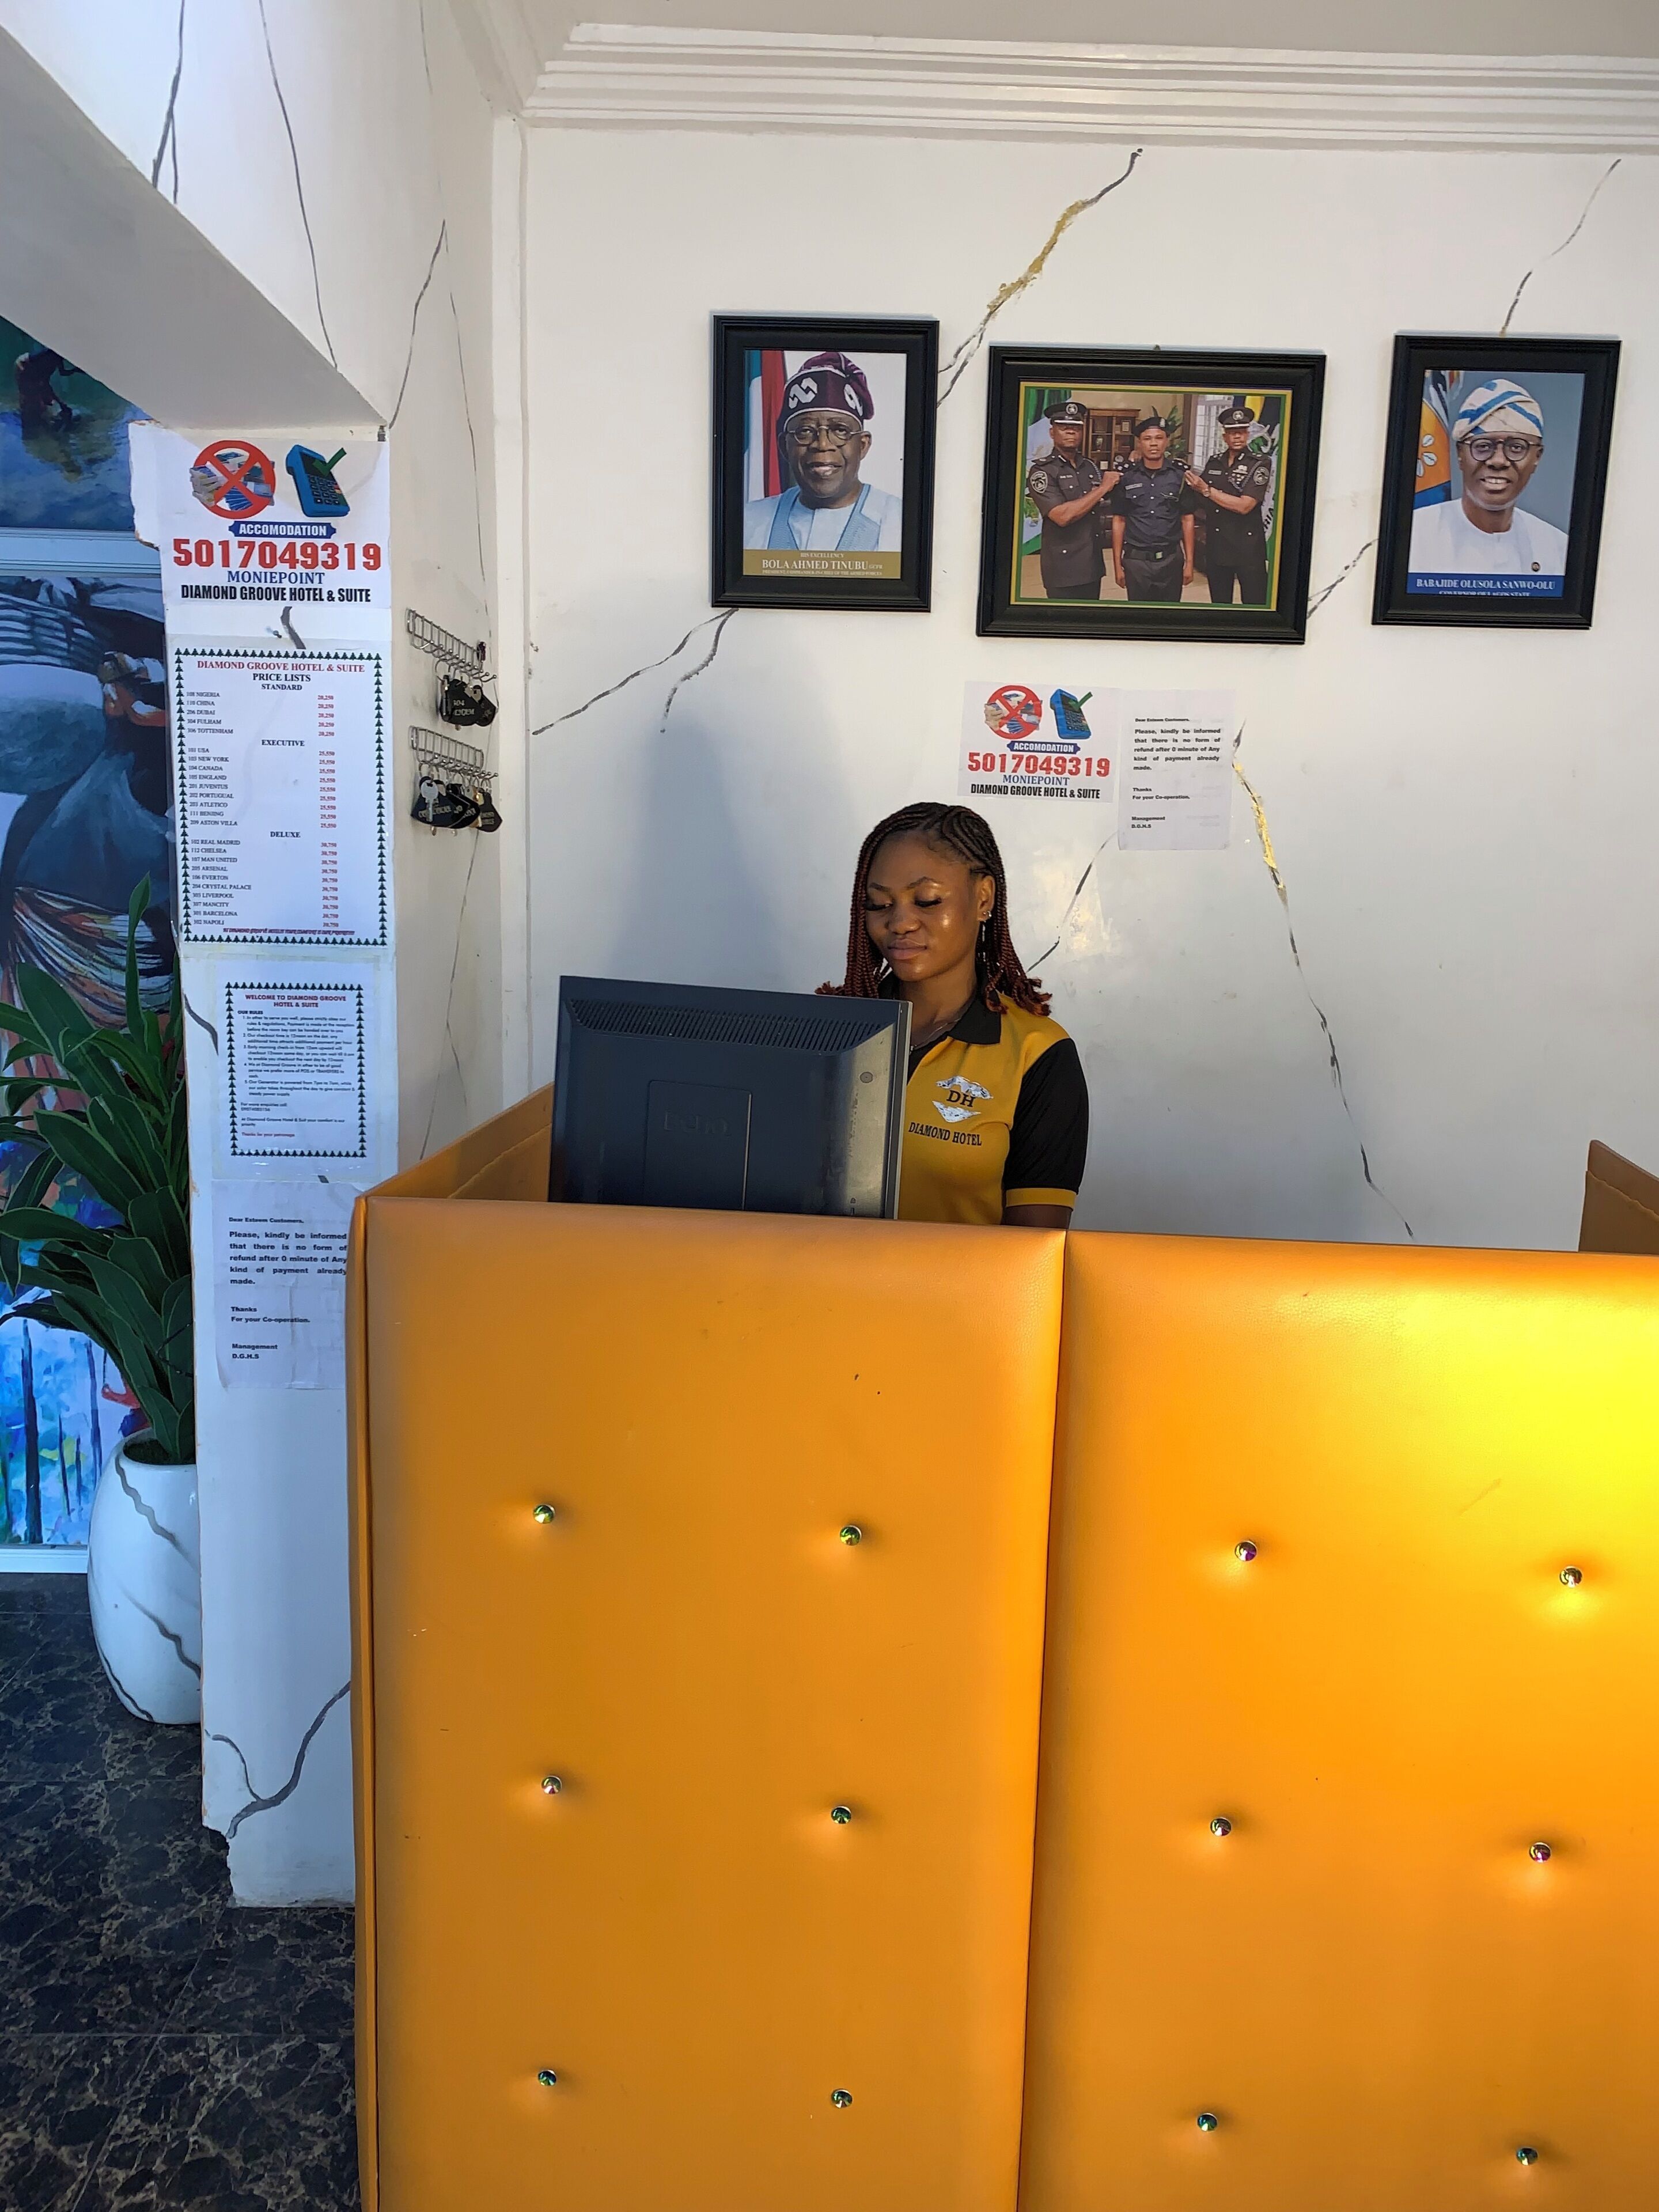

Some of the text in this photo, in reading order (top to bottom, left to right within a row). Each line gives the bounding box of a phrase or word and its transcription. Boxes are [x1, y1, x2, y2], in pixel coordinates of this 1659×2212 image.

[239, 524, 327, 536] ACCOMODATION
[173, 539, 381, 570] 5017049319
[763, 560, 868, 570] BOLA AHMED TINUBU
[228, 571, 325, 584] MONIEPOINT
[1416, 579, 1555, 589] BABAJIDE OLUSOLA SANWO-OLU
[181, 585, 370, 602] DIAMOND GROOVE HOTEL & SUITE
[198, 661, 244, 669] DIAMOND
[1014, 742, 1074, 752] ACCOMODATION
[968, 752, 1110, 777] 5017049319
[1002, 774, 1070, 785] MONIEPOINT
[971, 784, 1100, 799] DIAMOND GROOVE HOTEL & SUITE
[946, 1090, 975, 1107] DH
[908, 1122, 982, 1146] DIAMOND HOTEL
